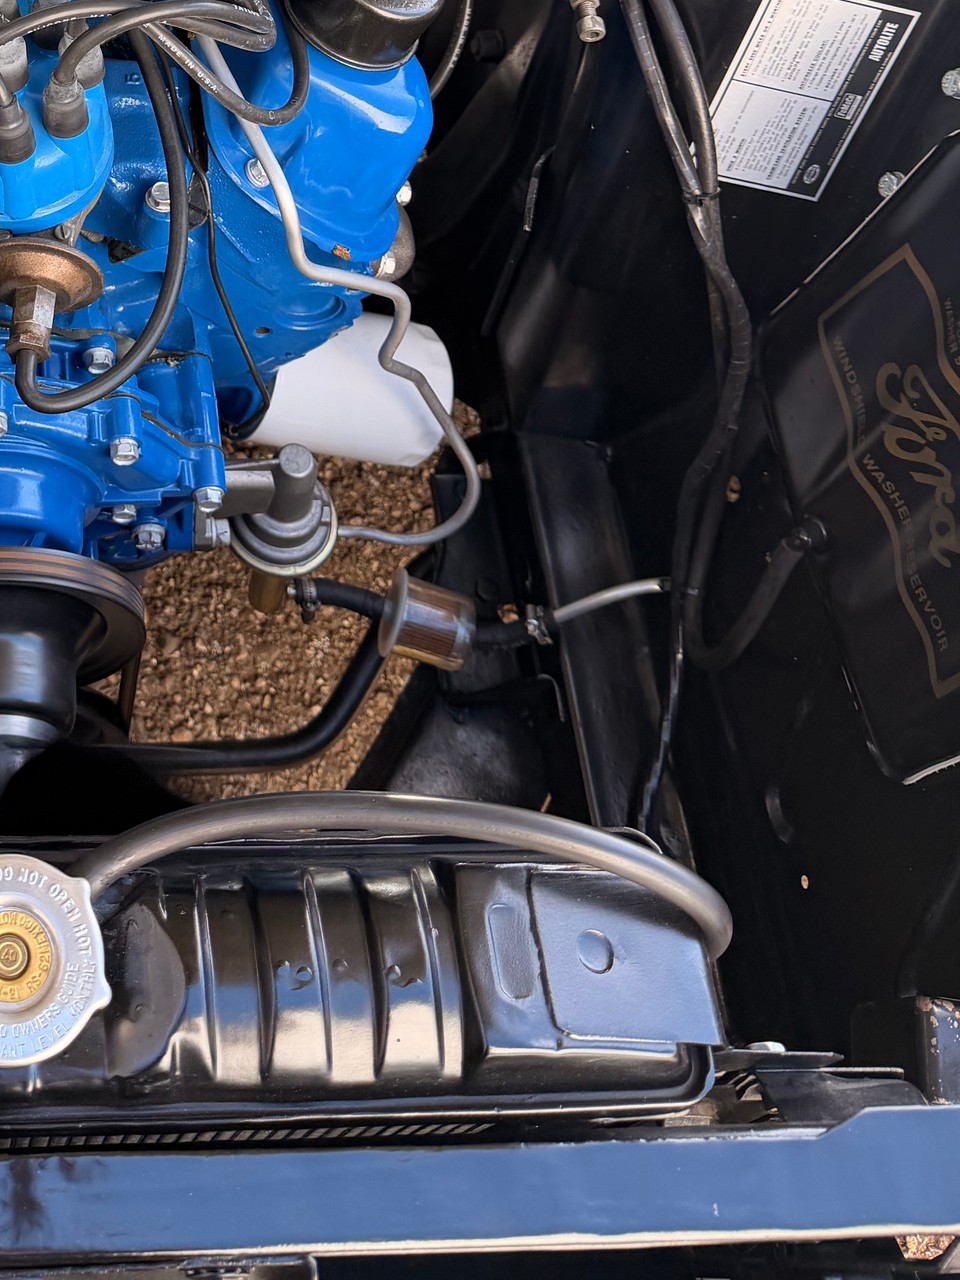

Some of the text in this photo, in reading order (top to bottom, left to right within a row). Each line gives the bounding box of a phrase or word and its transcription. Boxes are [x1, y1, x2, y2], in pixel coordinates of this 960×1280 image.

[462, 7, 472, 35] MADE
[866, 20, 900, 62] AUTOLITE
[157, 33, 219, 94] MADE IN U.S.A.
[832, 334, 948, 652] WINDSHIELD WASHER RESERVOIR
[17, 867, 48, 888] NOT
[49, 883, 81, 924] OPEN
[74, 923, 92, 956] HOT
[12, 1004, 61, 1038] OWNERS
[58, 962, 81, 1004] GUIDE
[32, 1022, 73, 1053] LEVEL
[68, 960, 96, 1019] MONTHLY
